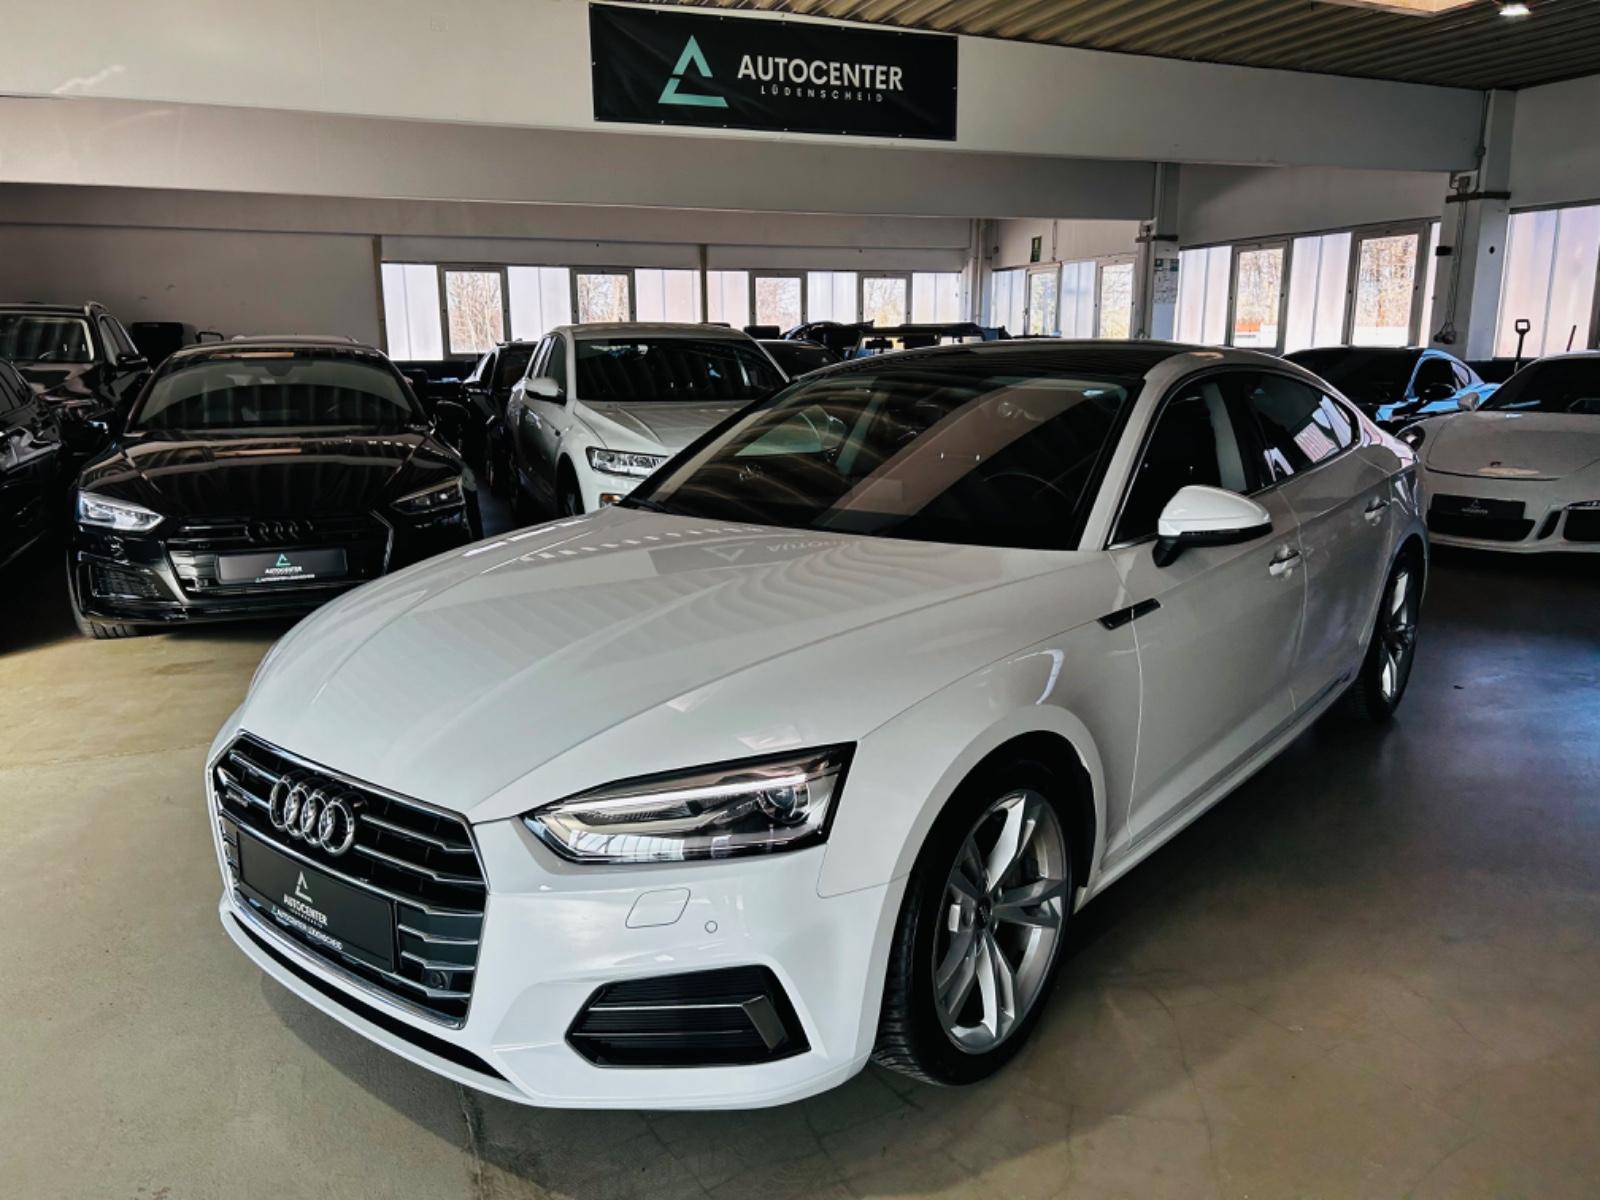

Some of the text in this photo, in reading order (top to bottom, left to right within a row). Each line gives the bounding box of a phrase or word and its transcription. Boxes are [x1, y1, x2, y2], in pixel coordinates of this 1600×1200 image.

[737, 55, 903, 91] AUTOCENTER
[761, 85, 883, 102] LÜDENSCHEID
[283, 894, 328, 926] AUTOCENTER
